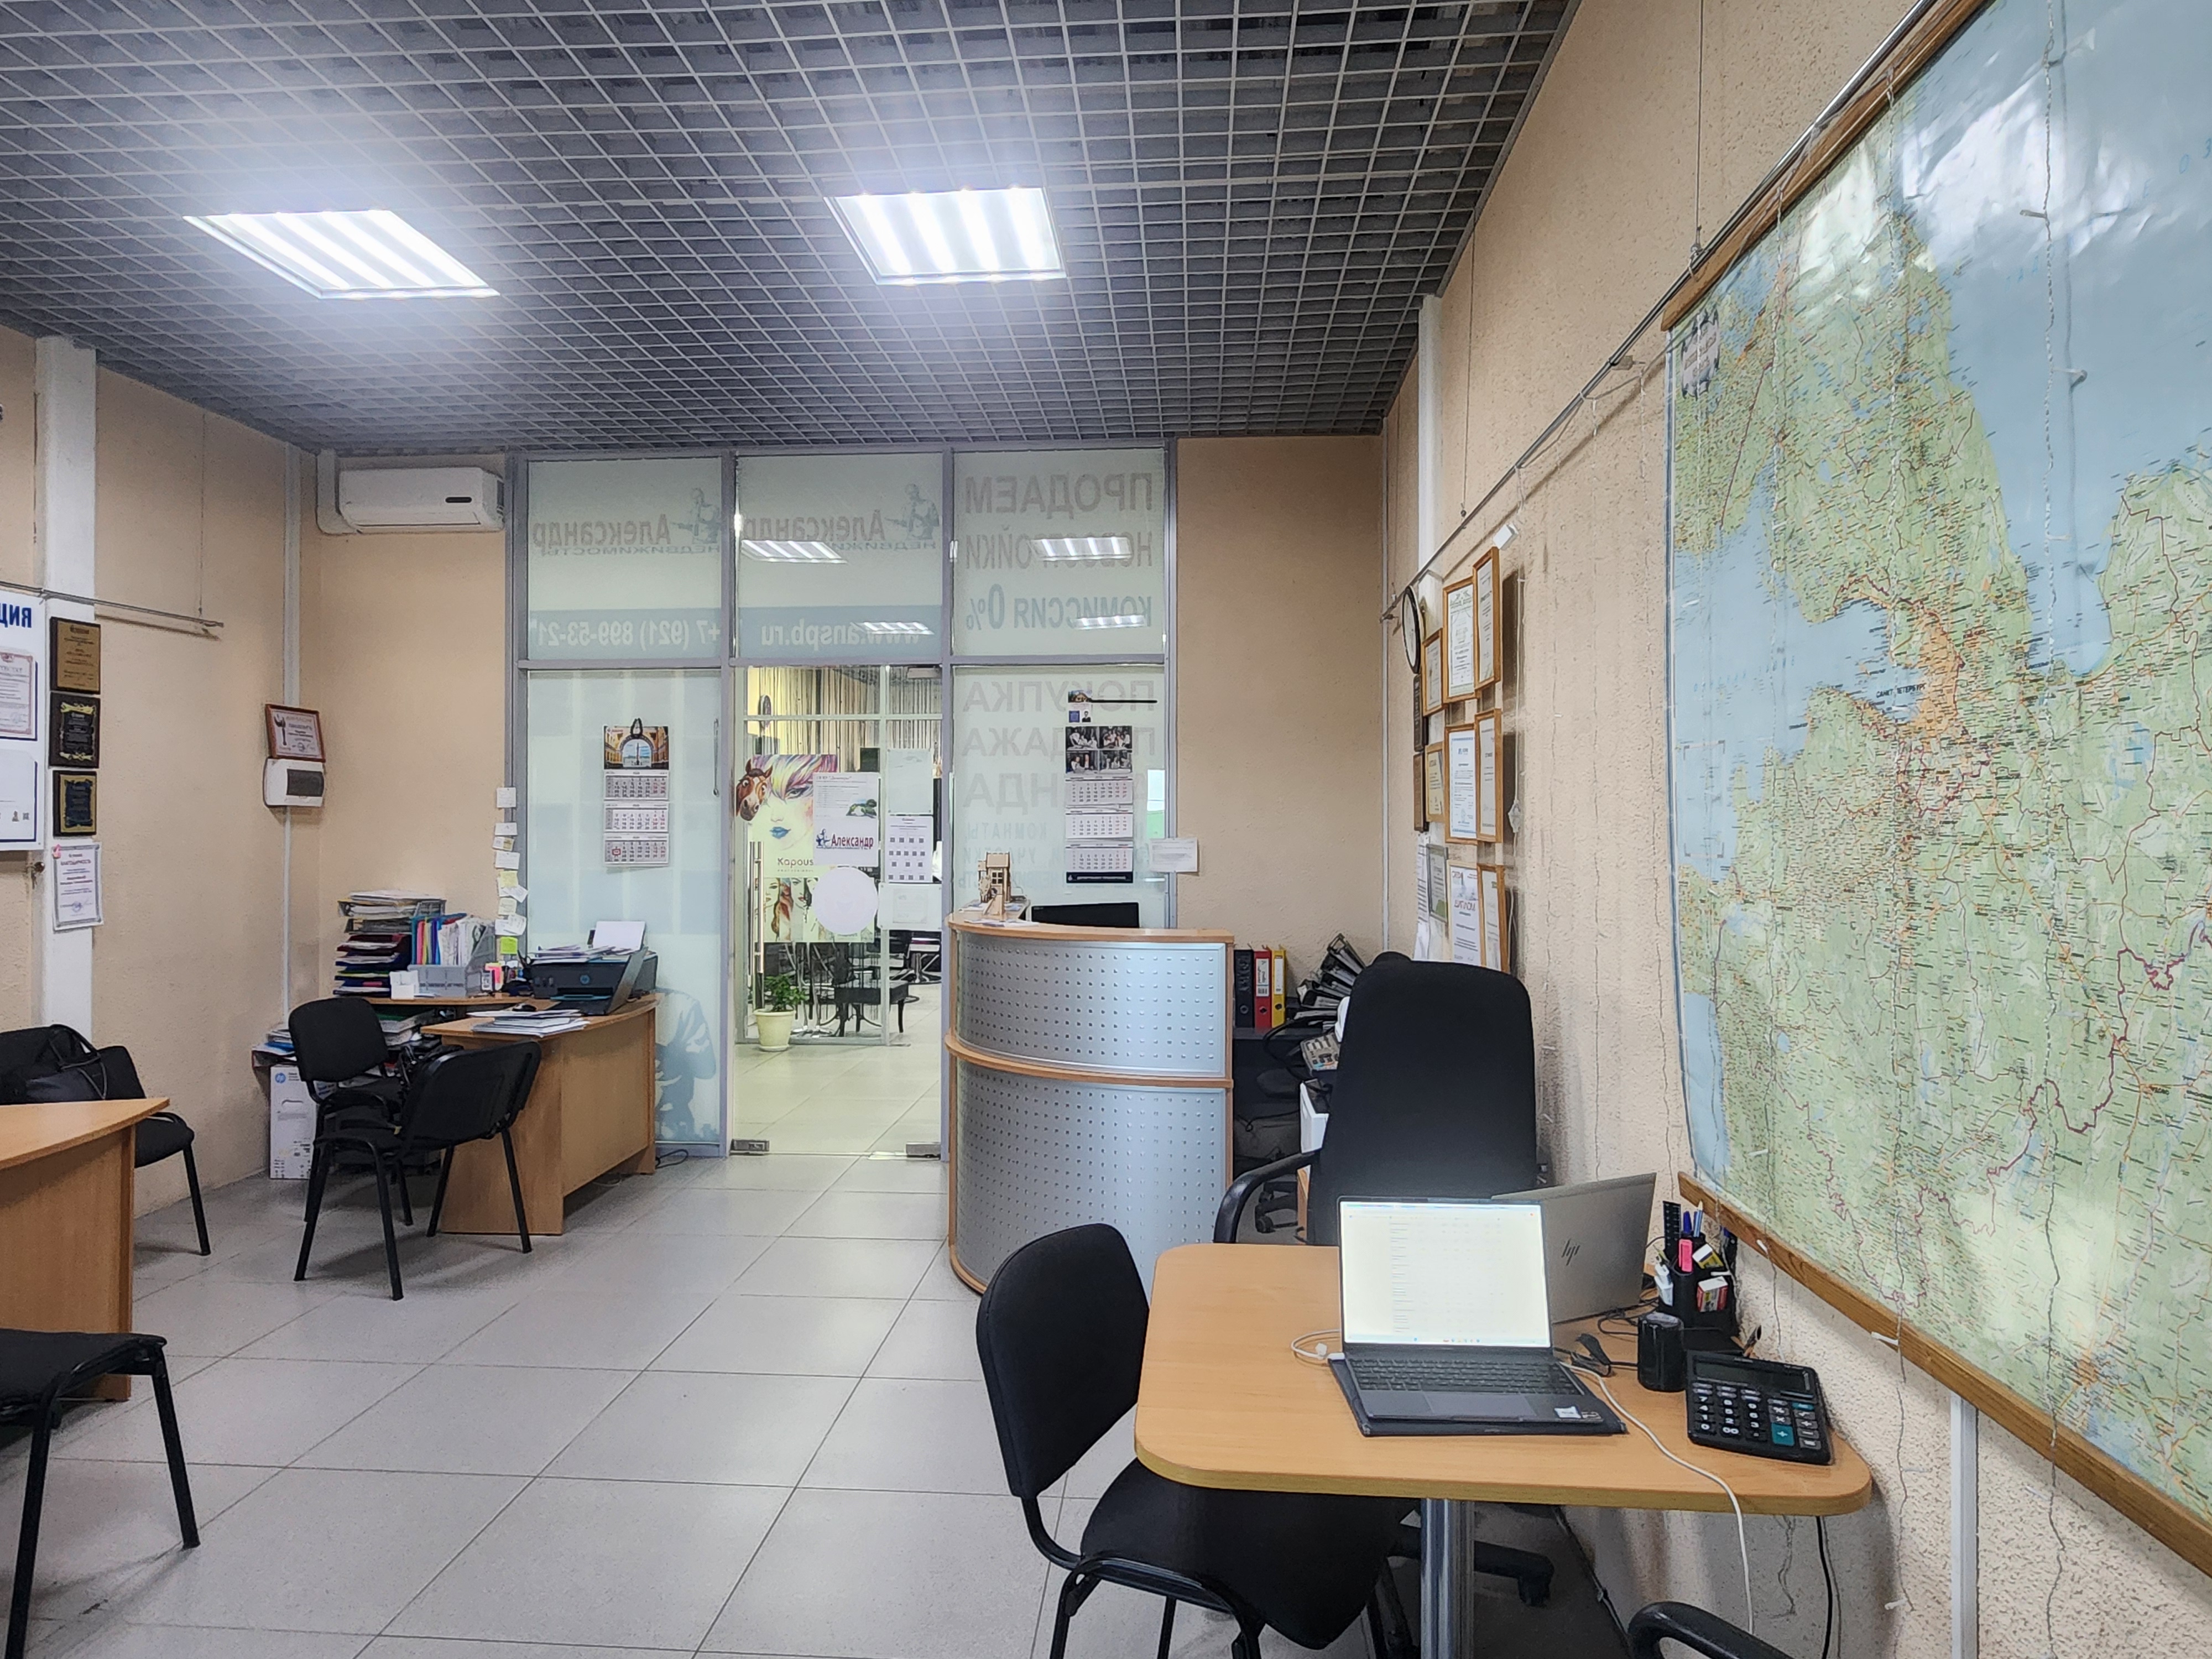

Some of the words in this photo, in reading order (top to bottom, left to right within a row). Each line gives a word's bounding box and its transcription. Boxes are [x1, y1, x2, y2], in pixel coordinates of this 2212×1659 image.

[831, 834, 874, 849] Александр
[778, 858, 814, 868] Kapous
[1561, 1238, 1580, 1266] hp
